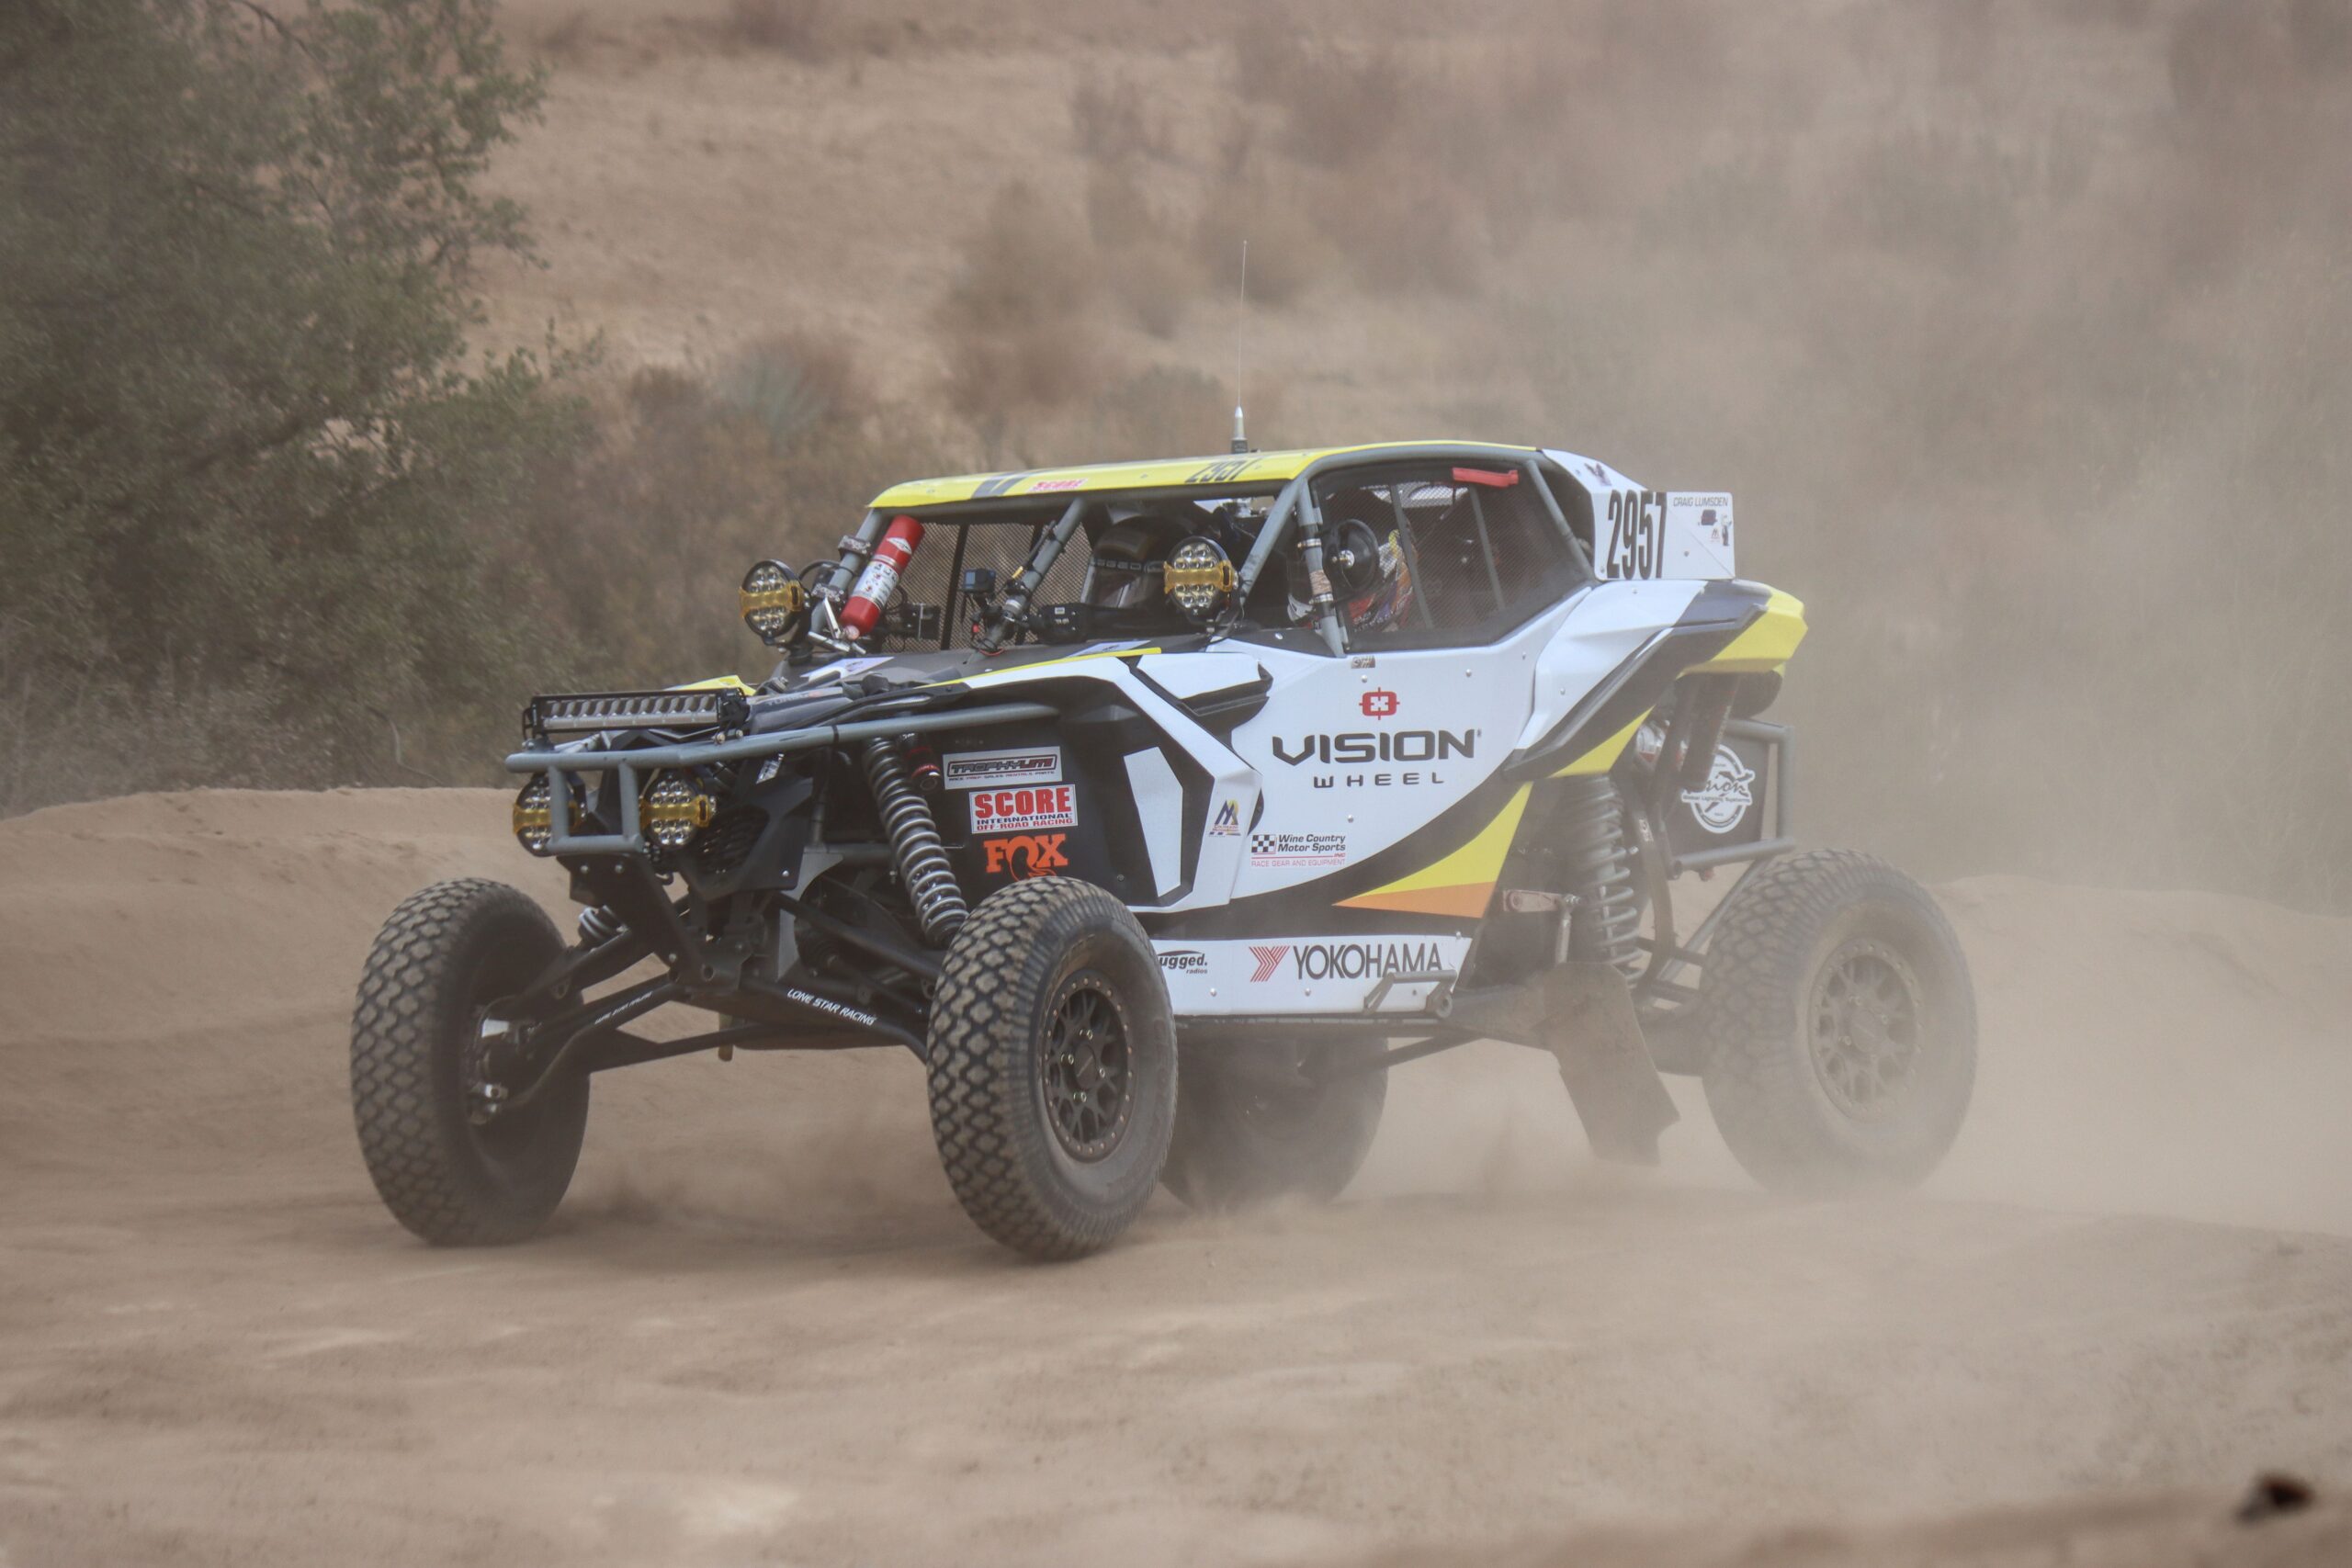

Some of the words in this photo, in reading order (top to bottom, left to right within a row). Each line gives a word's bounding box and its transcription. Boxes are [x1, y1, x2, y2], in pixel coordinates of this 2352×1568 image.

[1607, 490, 1667, 580] 2957
[1272, 729, 1475, 766] VISION
[1314, 773, 1444, 788] WHEEL
[974, 787, 1072, 818] SCORE
[977, 813, 1070, 825] INTERNATIONAL
[1033, 818, 1073, 827] RACING
[1277, 843, 1310, 852] Motor
[1311, 842, 1346, 854] Sports
[1278, 834, 1305, 842] Wine
[1306, 834, 1346, 843] Country
[983, 833, 1069, 874] FOX
[1159, 953, 1208, 970] ugged.
[1294, 942, 1442, 980] YOKOHAMA
[786, 988, 814, 1004] LONE
[813, 998, 841, 1012] STAR
[840, 1007, 877, 1026] RACING
